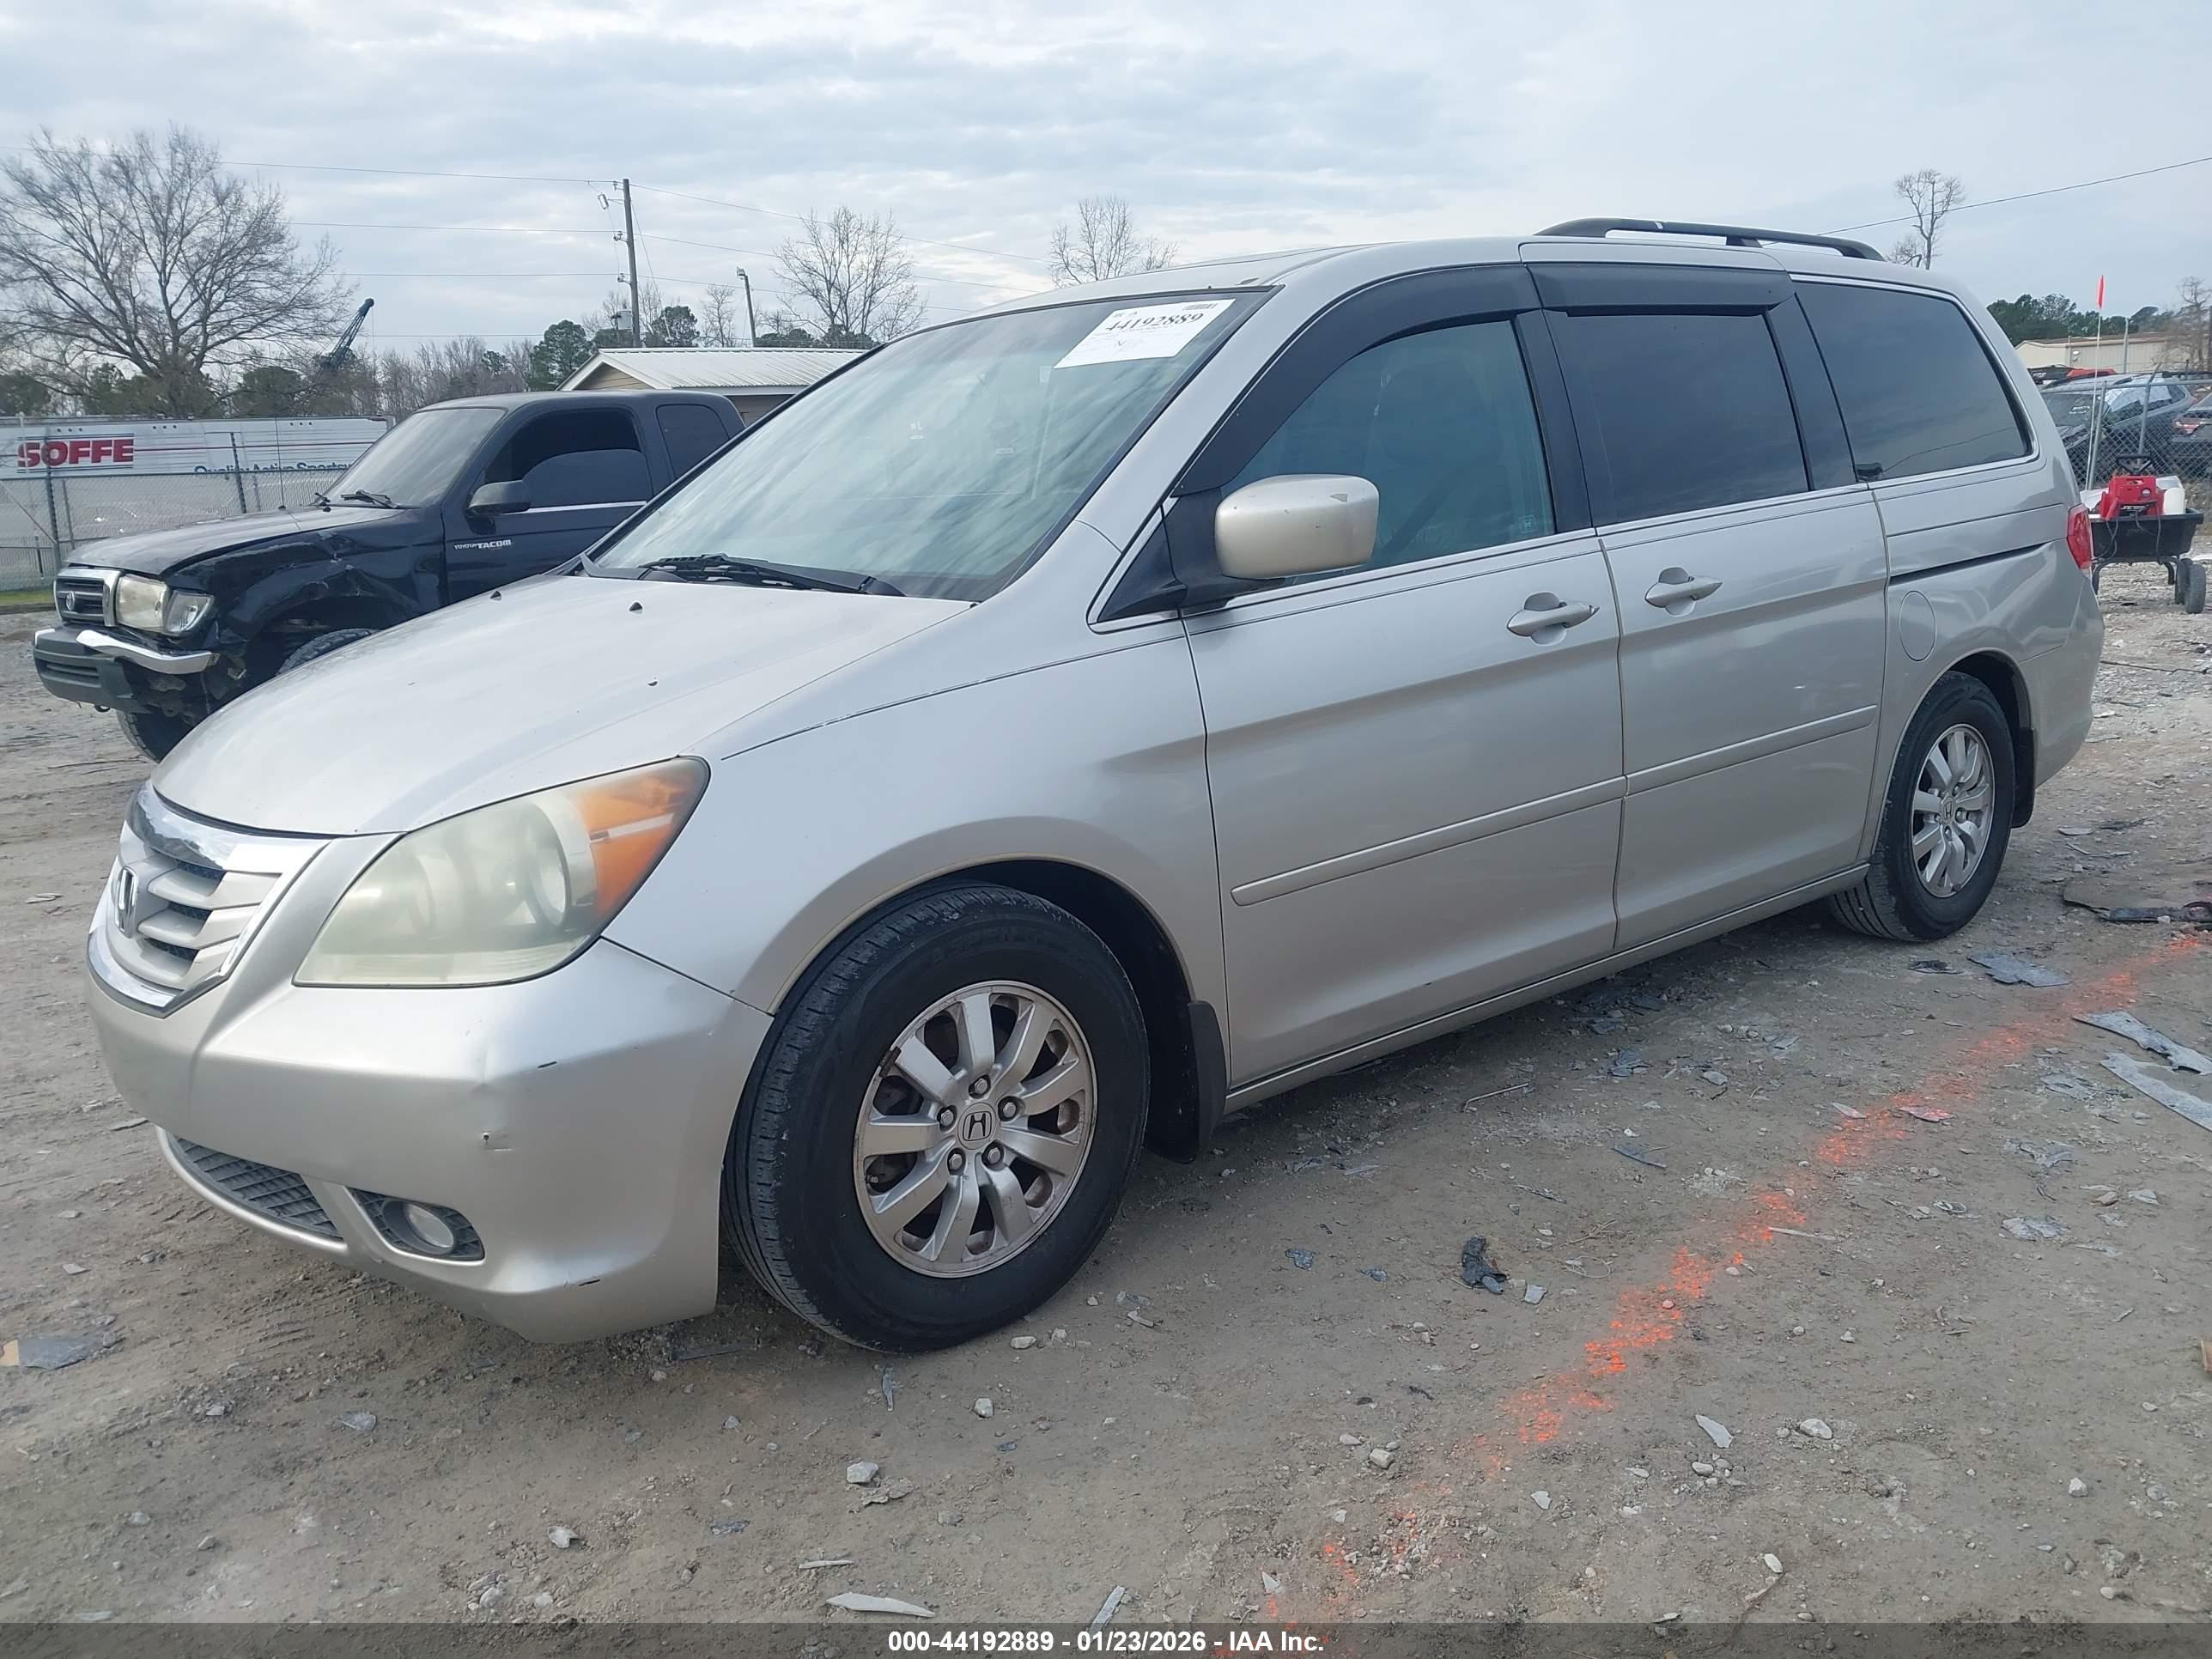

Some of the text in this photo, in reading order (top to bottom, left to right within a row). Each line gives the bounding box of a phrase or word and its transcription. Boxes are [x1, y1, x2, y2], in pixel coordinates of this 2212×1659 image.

[1105, 313, 1204, 331] 44192889
[17, 439, 134, 468] SOFFE
[194, 462, 354, 473] Qali Atie Sorts
